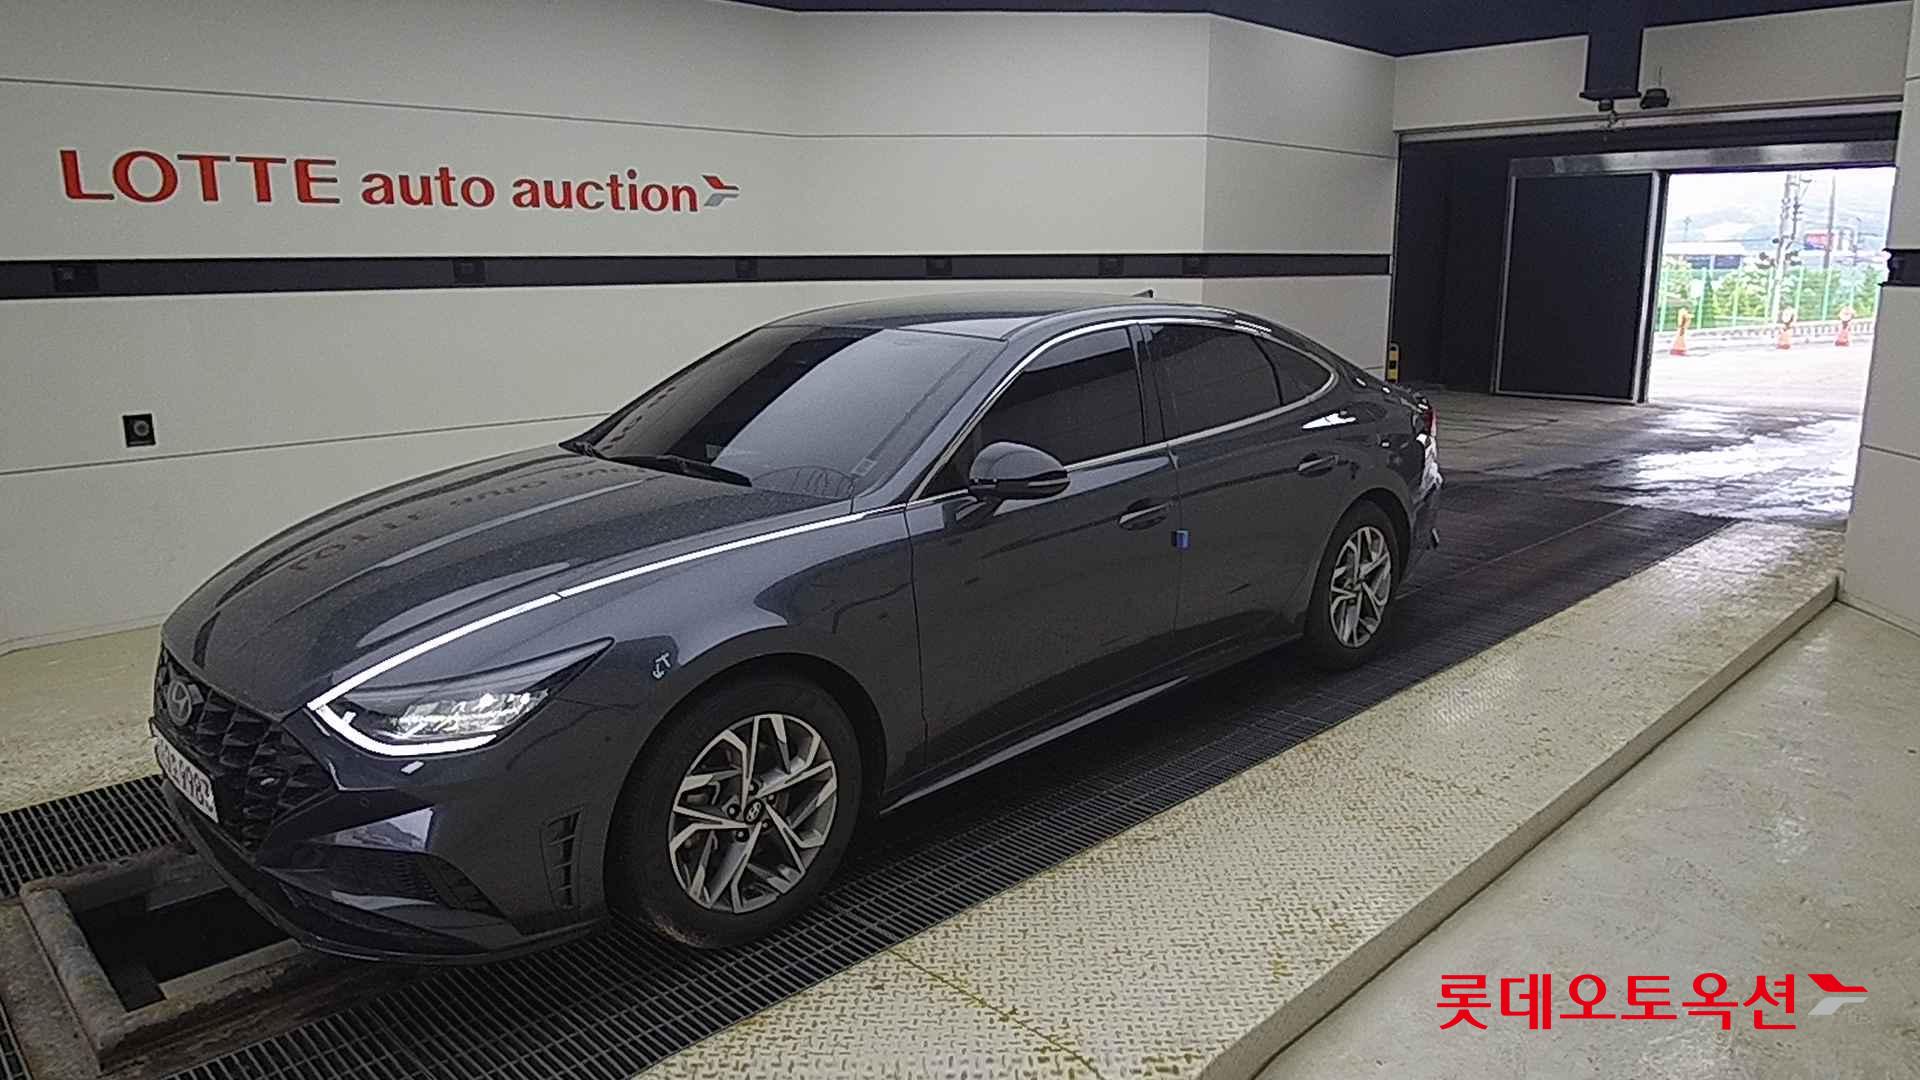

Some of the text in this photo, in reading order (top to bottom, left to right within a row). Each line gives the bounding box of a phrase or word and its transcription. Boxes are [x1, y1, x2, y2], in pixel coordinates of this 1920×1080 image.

[60, 149, 699, 213] LOTTE auto auction
